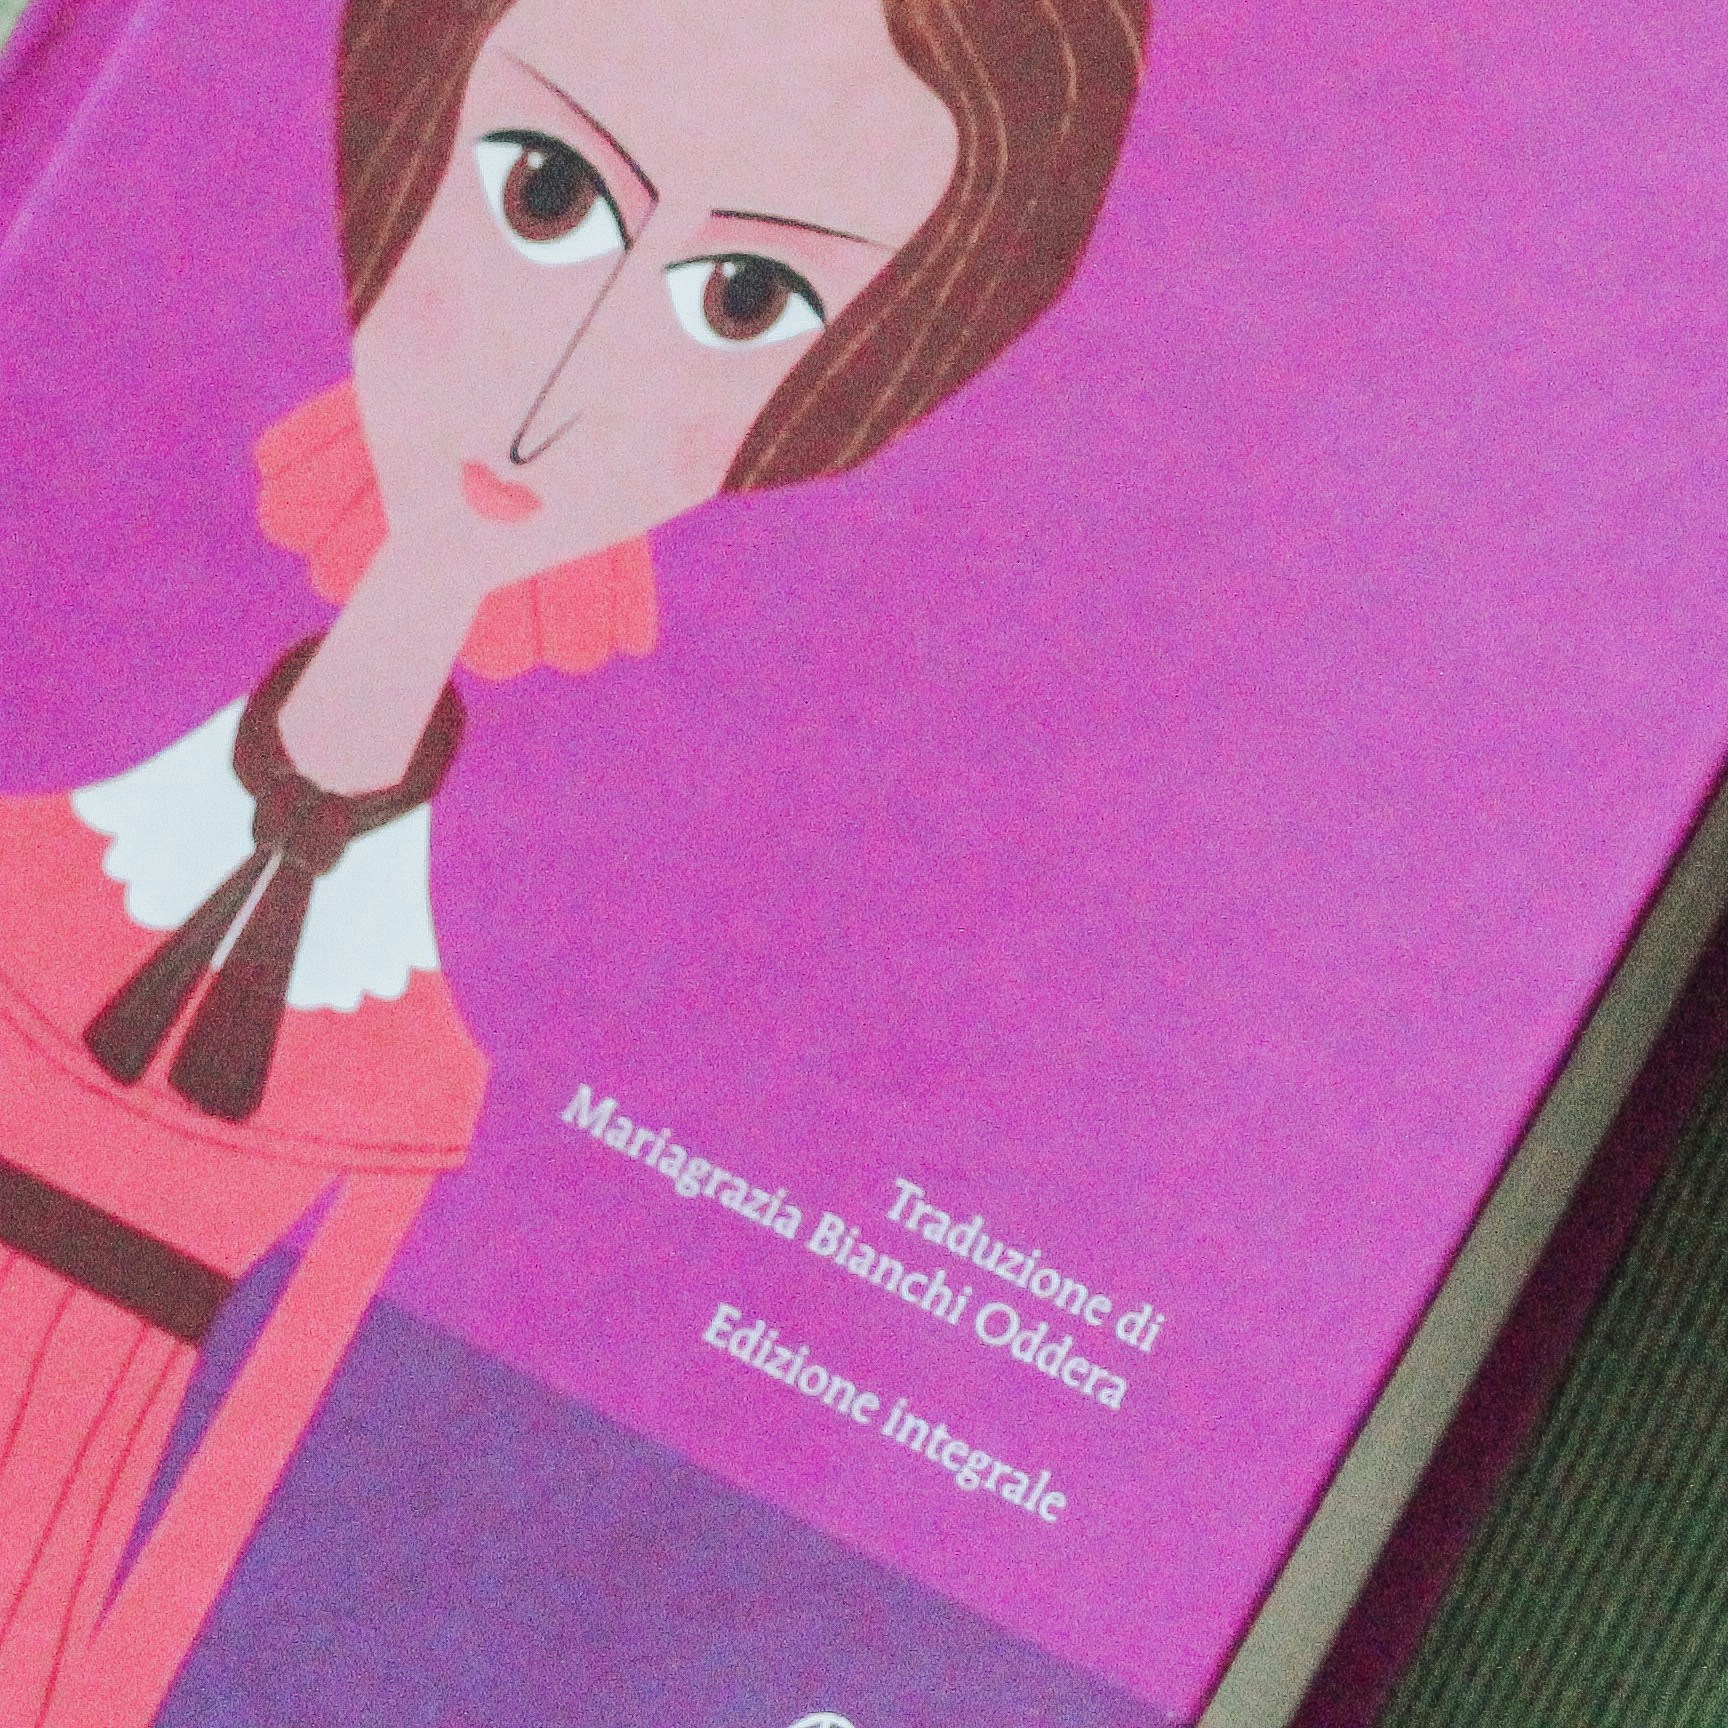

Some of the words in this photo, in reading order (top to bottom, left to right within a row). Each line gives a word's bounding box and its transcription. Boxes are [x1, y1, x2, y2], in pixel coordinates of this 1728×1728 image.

[560, 1083, 804, 1242] Mariagrazia
[804, 1210, 975, 1327] Bianchi
[972, 1299, 1130, 1412] Oddera
[885, 1175, 1114, 1327] Traduzione
[1112, 1300, 1168, 1355] di
[700, 1302, 882, 1425] Edizione
[879, 1396, 1069, 1525] integrale
